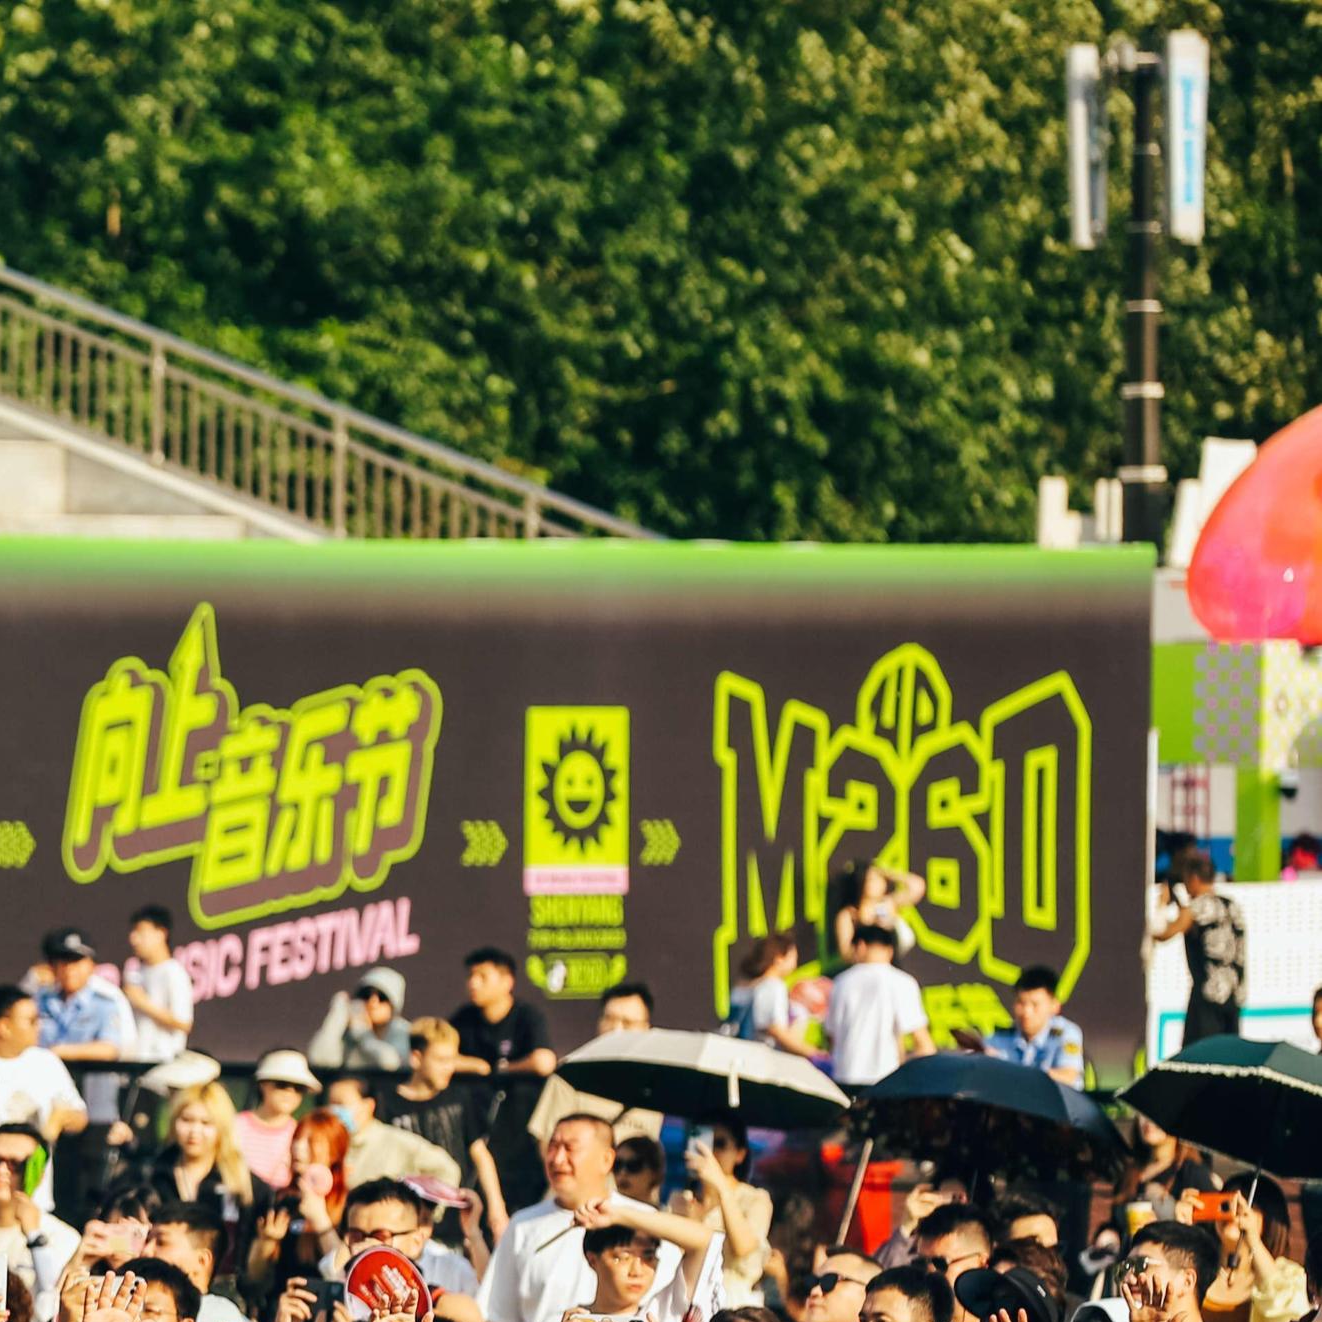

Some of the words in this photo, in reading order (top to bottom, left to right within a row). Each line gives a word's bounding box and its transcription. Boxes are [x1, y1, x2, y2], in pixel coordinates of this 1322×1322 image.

[74, 606, 420, 890] 向上音乐节
[245, 896, 421, 990] FESTIVAL
